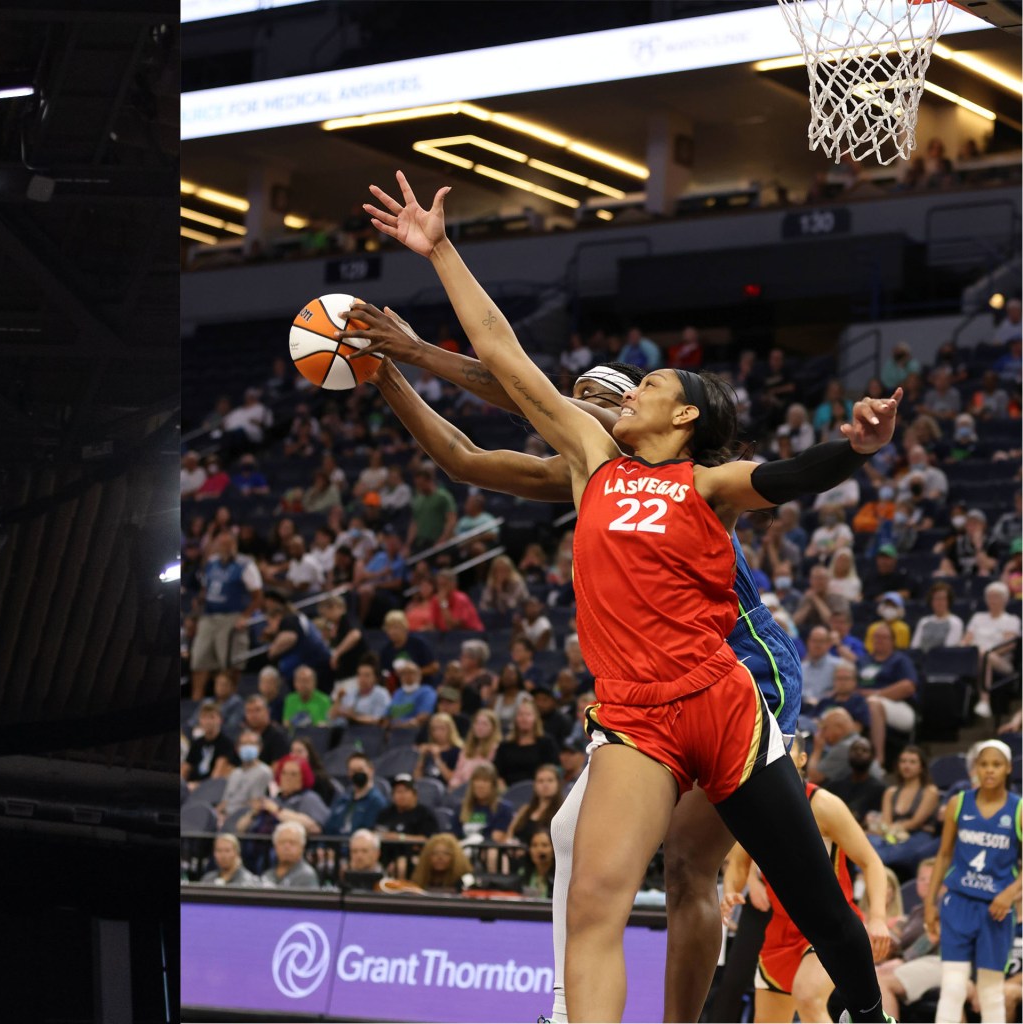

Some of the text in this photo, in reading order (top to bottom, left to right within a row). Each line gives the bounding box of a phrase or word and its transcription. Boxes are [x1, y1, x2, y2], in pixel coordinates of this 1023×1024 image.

[608, 498, 668, 534] 22
[969, 848, 987, 873] 4
[336, 944, 554, 994] Grant Thornton
